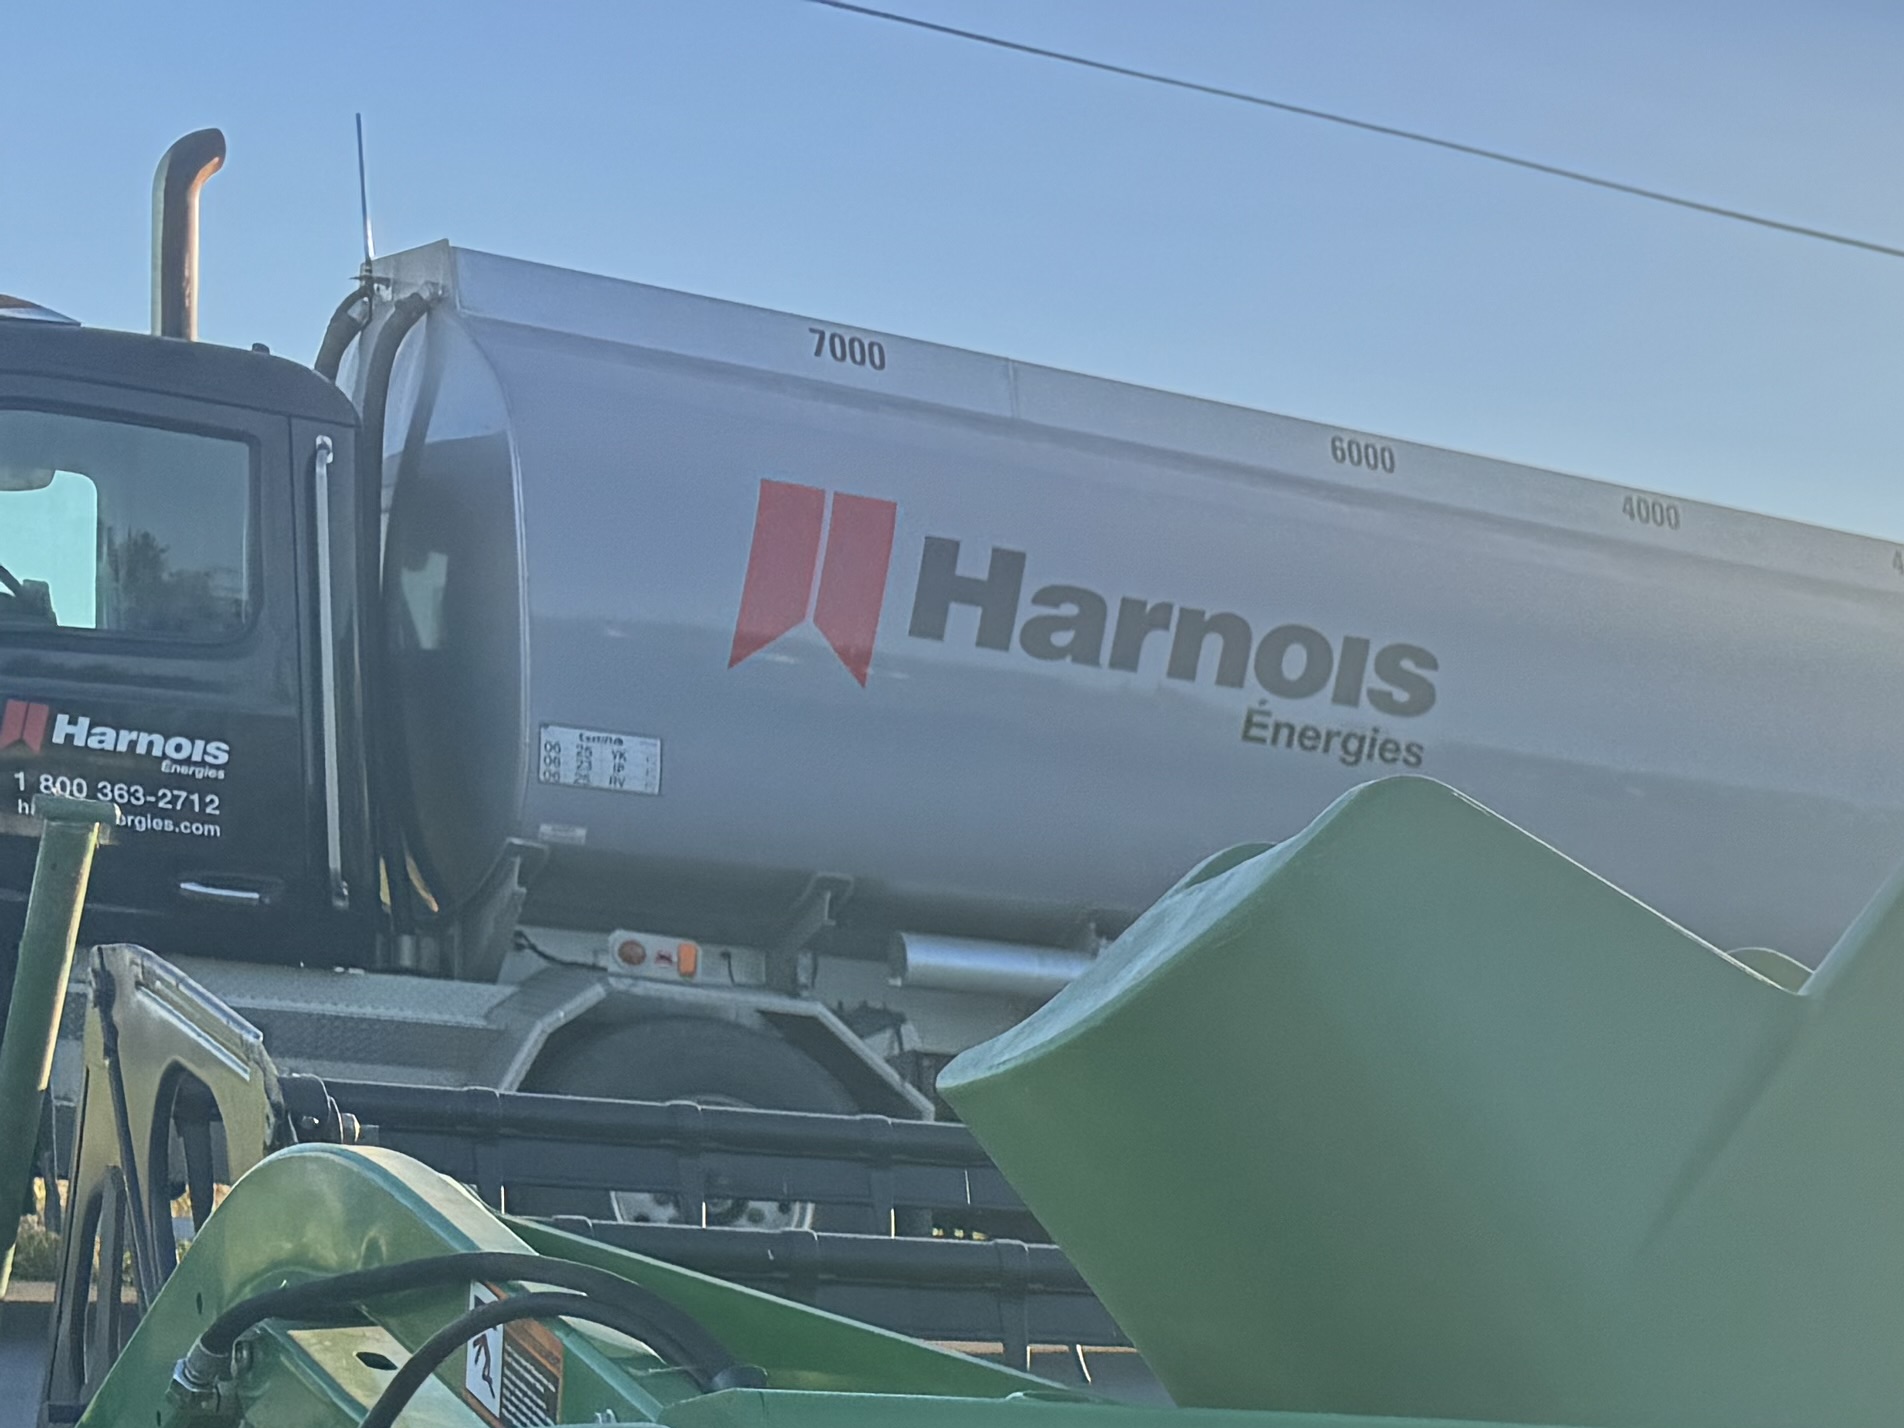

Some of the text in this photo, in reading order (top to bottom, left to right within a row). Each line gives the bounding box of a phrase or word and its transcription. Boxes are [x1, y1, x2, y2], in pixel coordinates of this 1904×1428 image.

[809, 328, 886, 371] 7000
[1329, 435, 1396, 475] 6000
[909, 535, 1438, 718] Harnois
[52, 713, 230, 765] Harnois
[1240, 701, 1424, 769] Énergies
[14, 772, 220, 815] 1 800 363-2712
